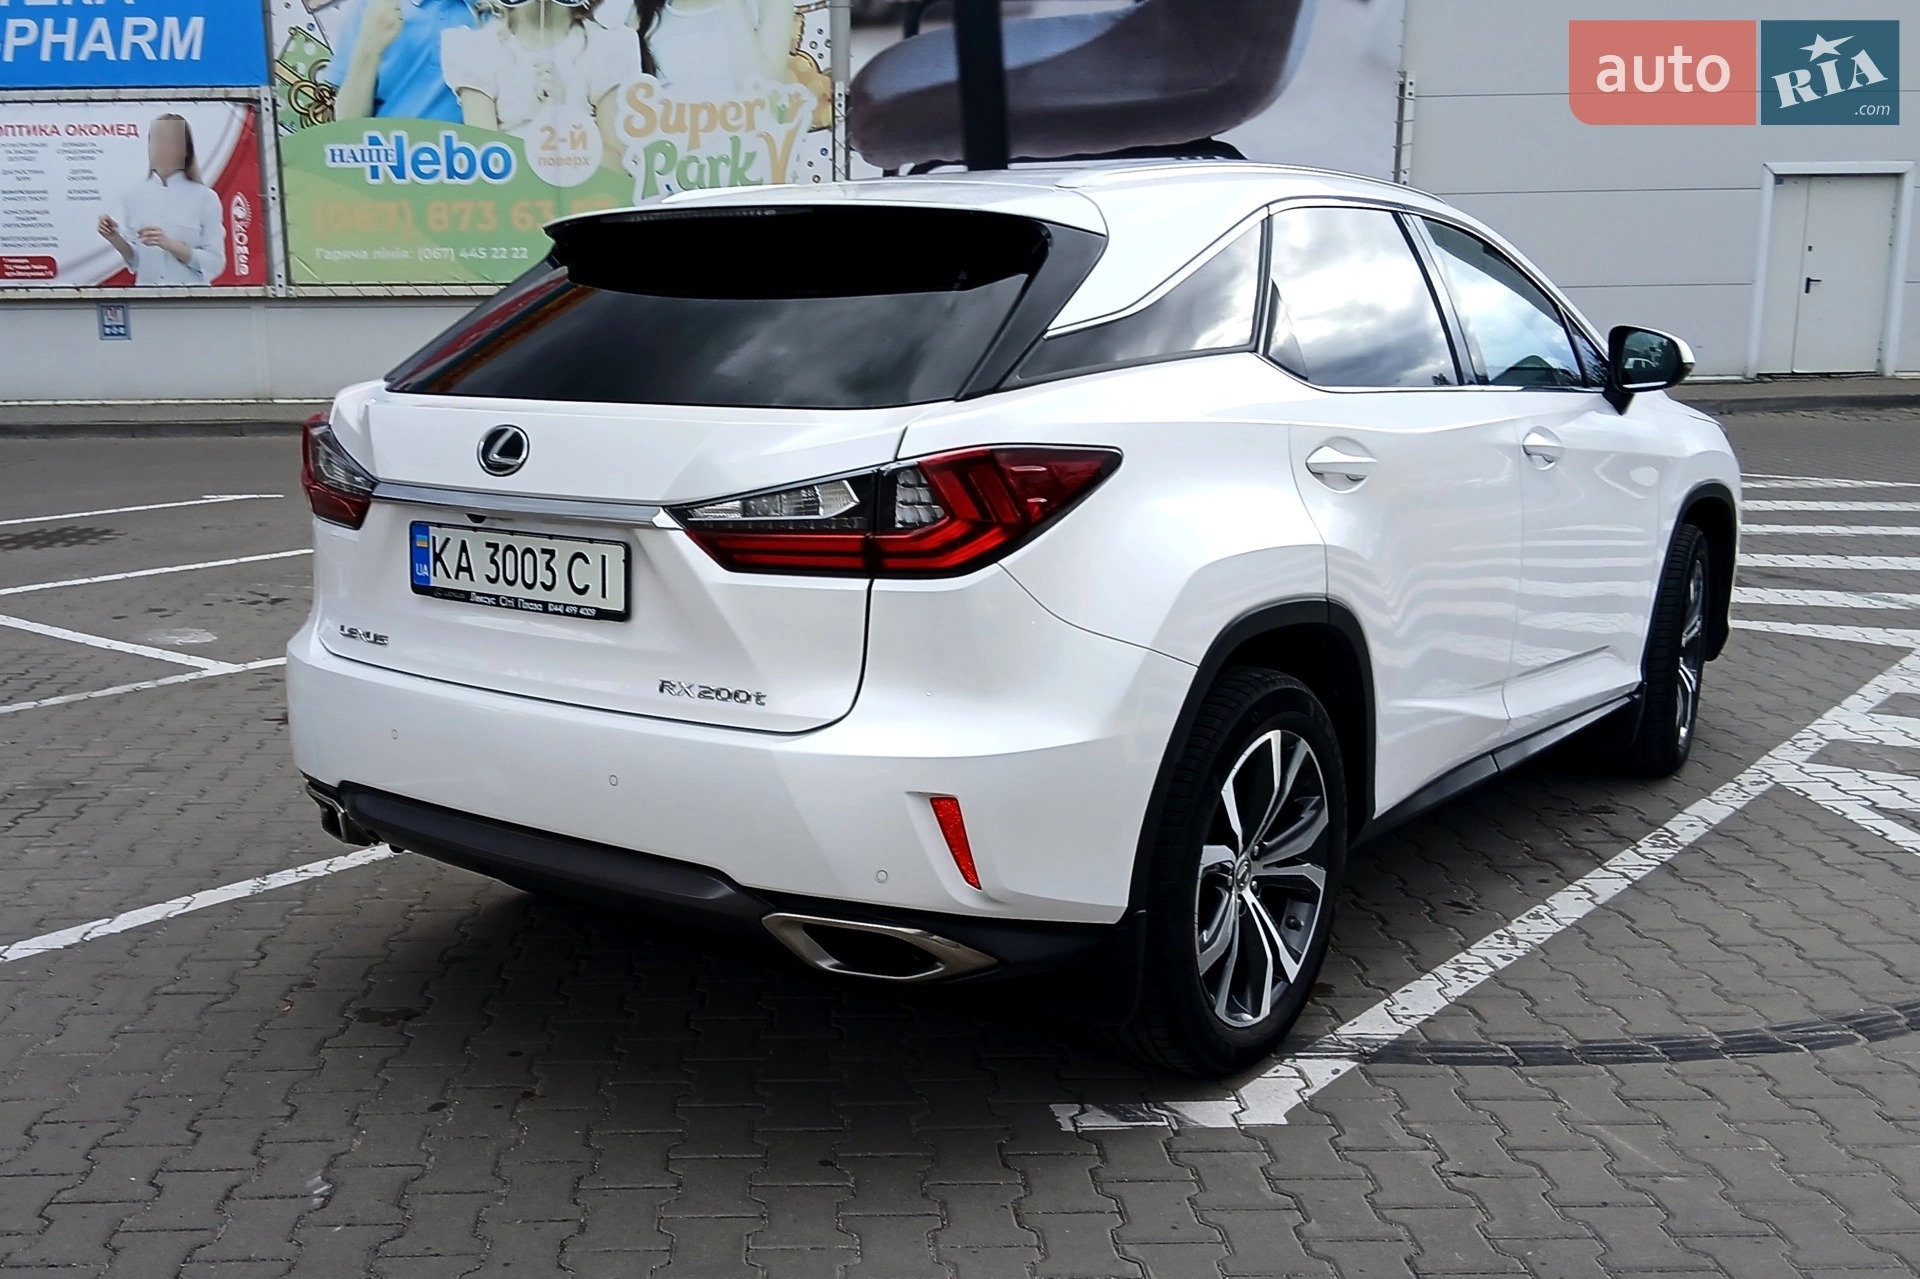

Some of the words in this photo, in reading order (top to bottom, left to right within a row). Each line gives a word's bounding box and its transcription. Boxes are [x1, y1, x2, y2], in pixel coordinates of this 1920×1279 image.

[0, 16, 205, 62] PHARM
[623, 82, 766, 152] Super
[64, 123, 140, 138] ОКОМЕД
[540, 124, 588, 150] 2-й
[329, 147, 396, 164] НАШЕ
[368, 134, 513, 181] Nebo
[537, 155, 591, 169] поверх
[313, 199, 414, 240] (067)
[427, 200, 499, 232] 873
[417, 247, 455, 262] (067)
[459, 247, 487, 260] 445
[491, 247, 508, 260] 22
[511, 247, 529, 260] 22
[415, 563, 430, 577] UA
[431, 536, 476, 583] KA
[485, 541, 557, 593] 3003
[339, 624, 389, 646] LEXUS
